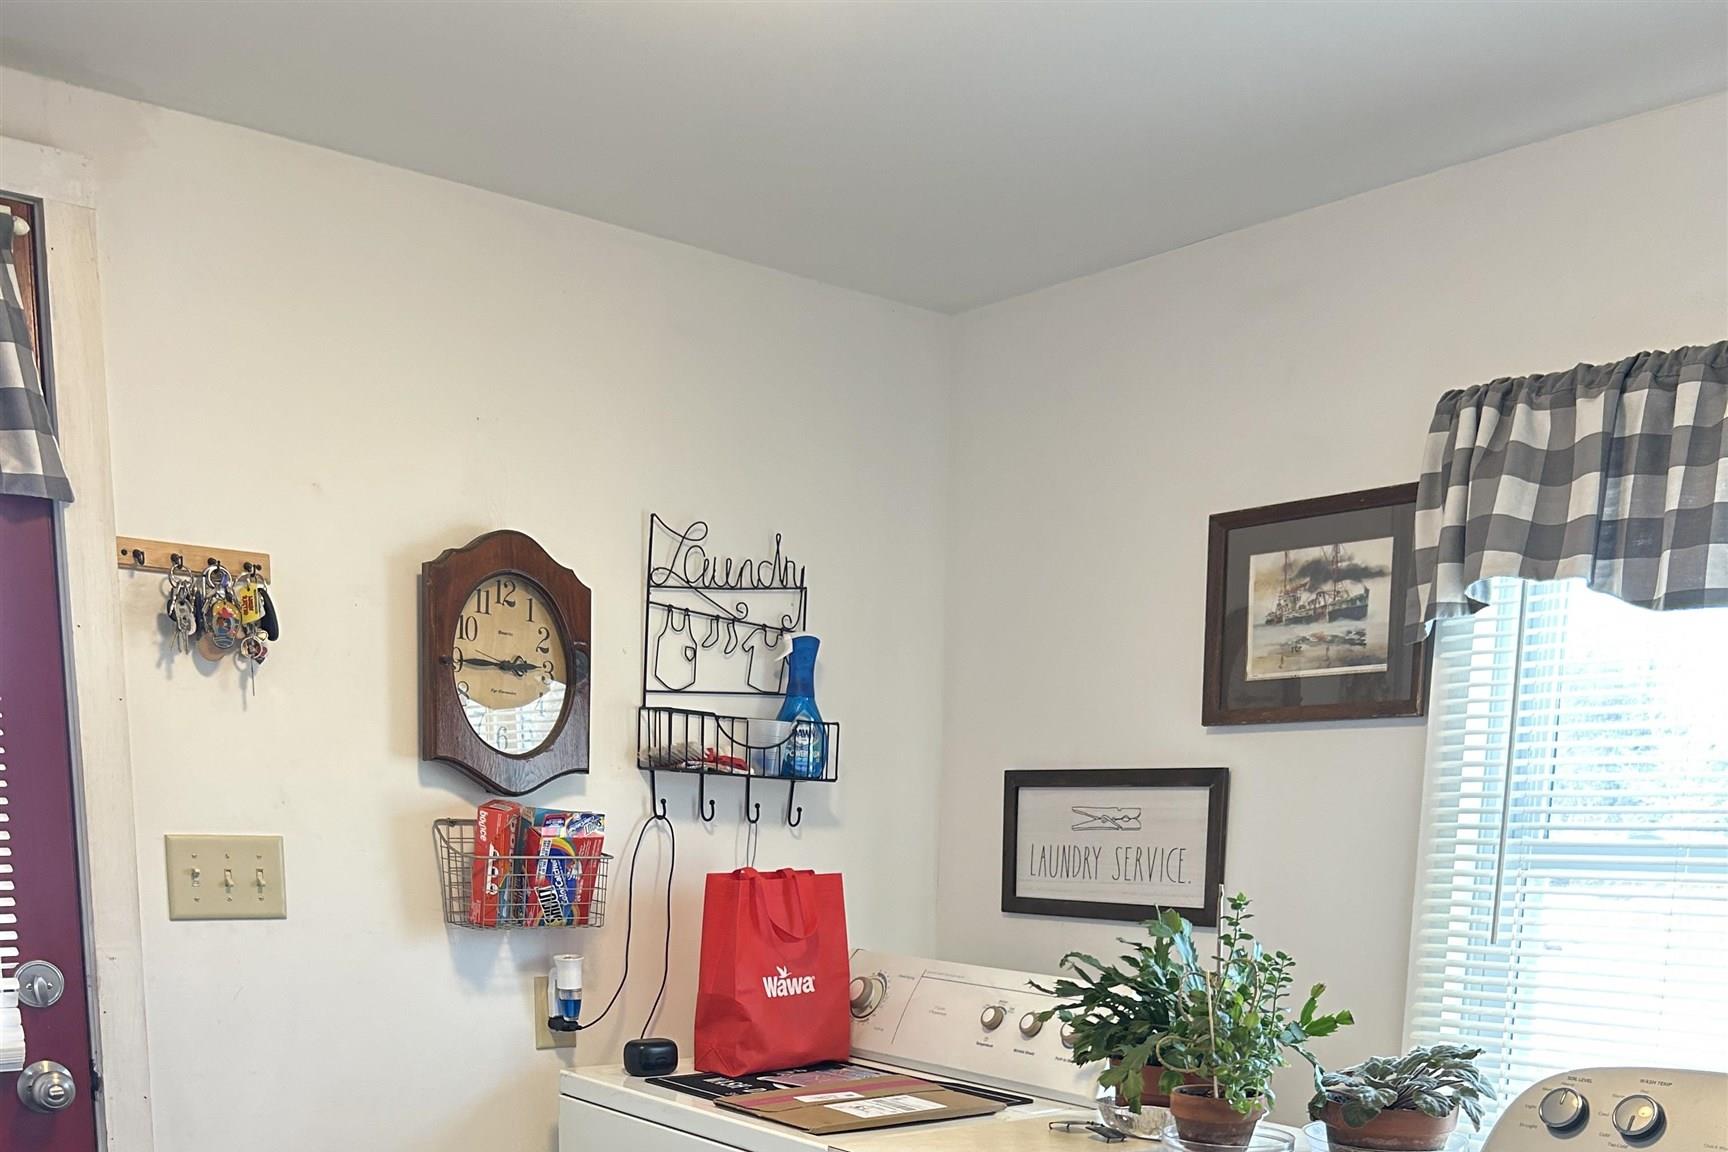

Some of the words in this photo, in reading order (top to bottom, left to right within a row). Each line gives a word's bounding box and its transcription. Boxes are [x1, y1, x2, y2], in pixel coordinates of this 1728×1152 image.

[475, 587, 492, 616] 11
[495, 579, 516, 608] 12
[525, 597, 535, 623] 1
[457, 614, 478, 642] 10
[535, 626, 550, 654] 2
[451, 646, 464, 673] 9
[541, 660, 555, 686] 3
[478, 810, 489, 842] bounce
[1030, 843, 1102, 880] LAUNDRY
[1111, 846, 1192, 884] SERVICE.
[763, 975, 816, 998] Wawa
